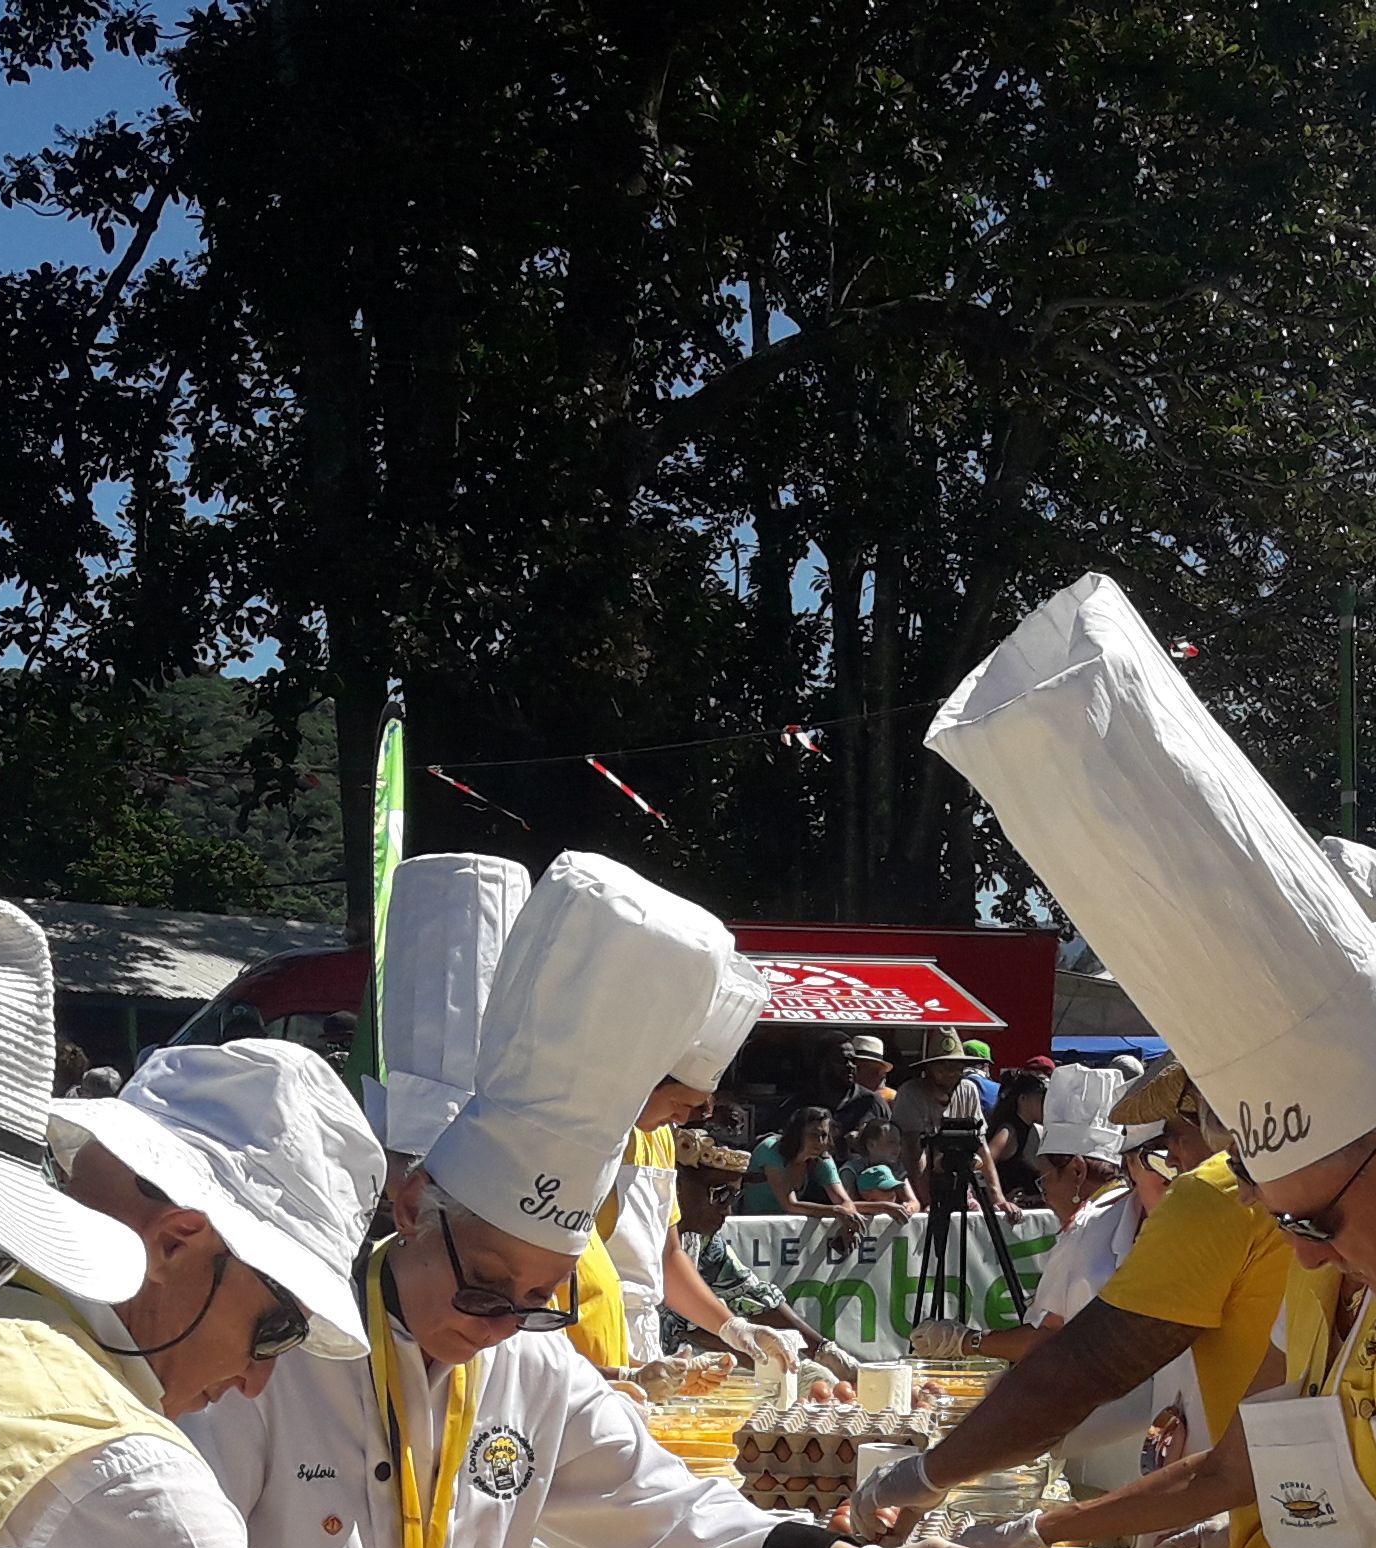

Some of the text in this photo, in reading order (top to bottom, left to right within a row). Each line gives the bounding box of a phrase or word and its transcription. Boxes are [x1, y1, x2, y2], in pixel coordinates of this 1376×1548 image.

[830, 989, 907, 999] PARC
[1229, 1100, 1312, 1158] béa
[784, 1235, 1060, 1342] mbé
